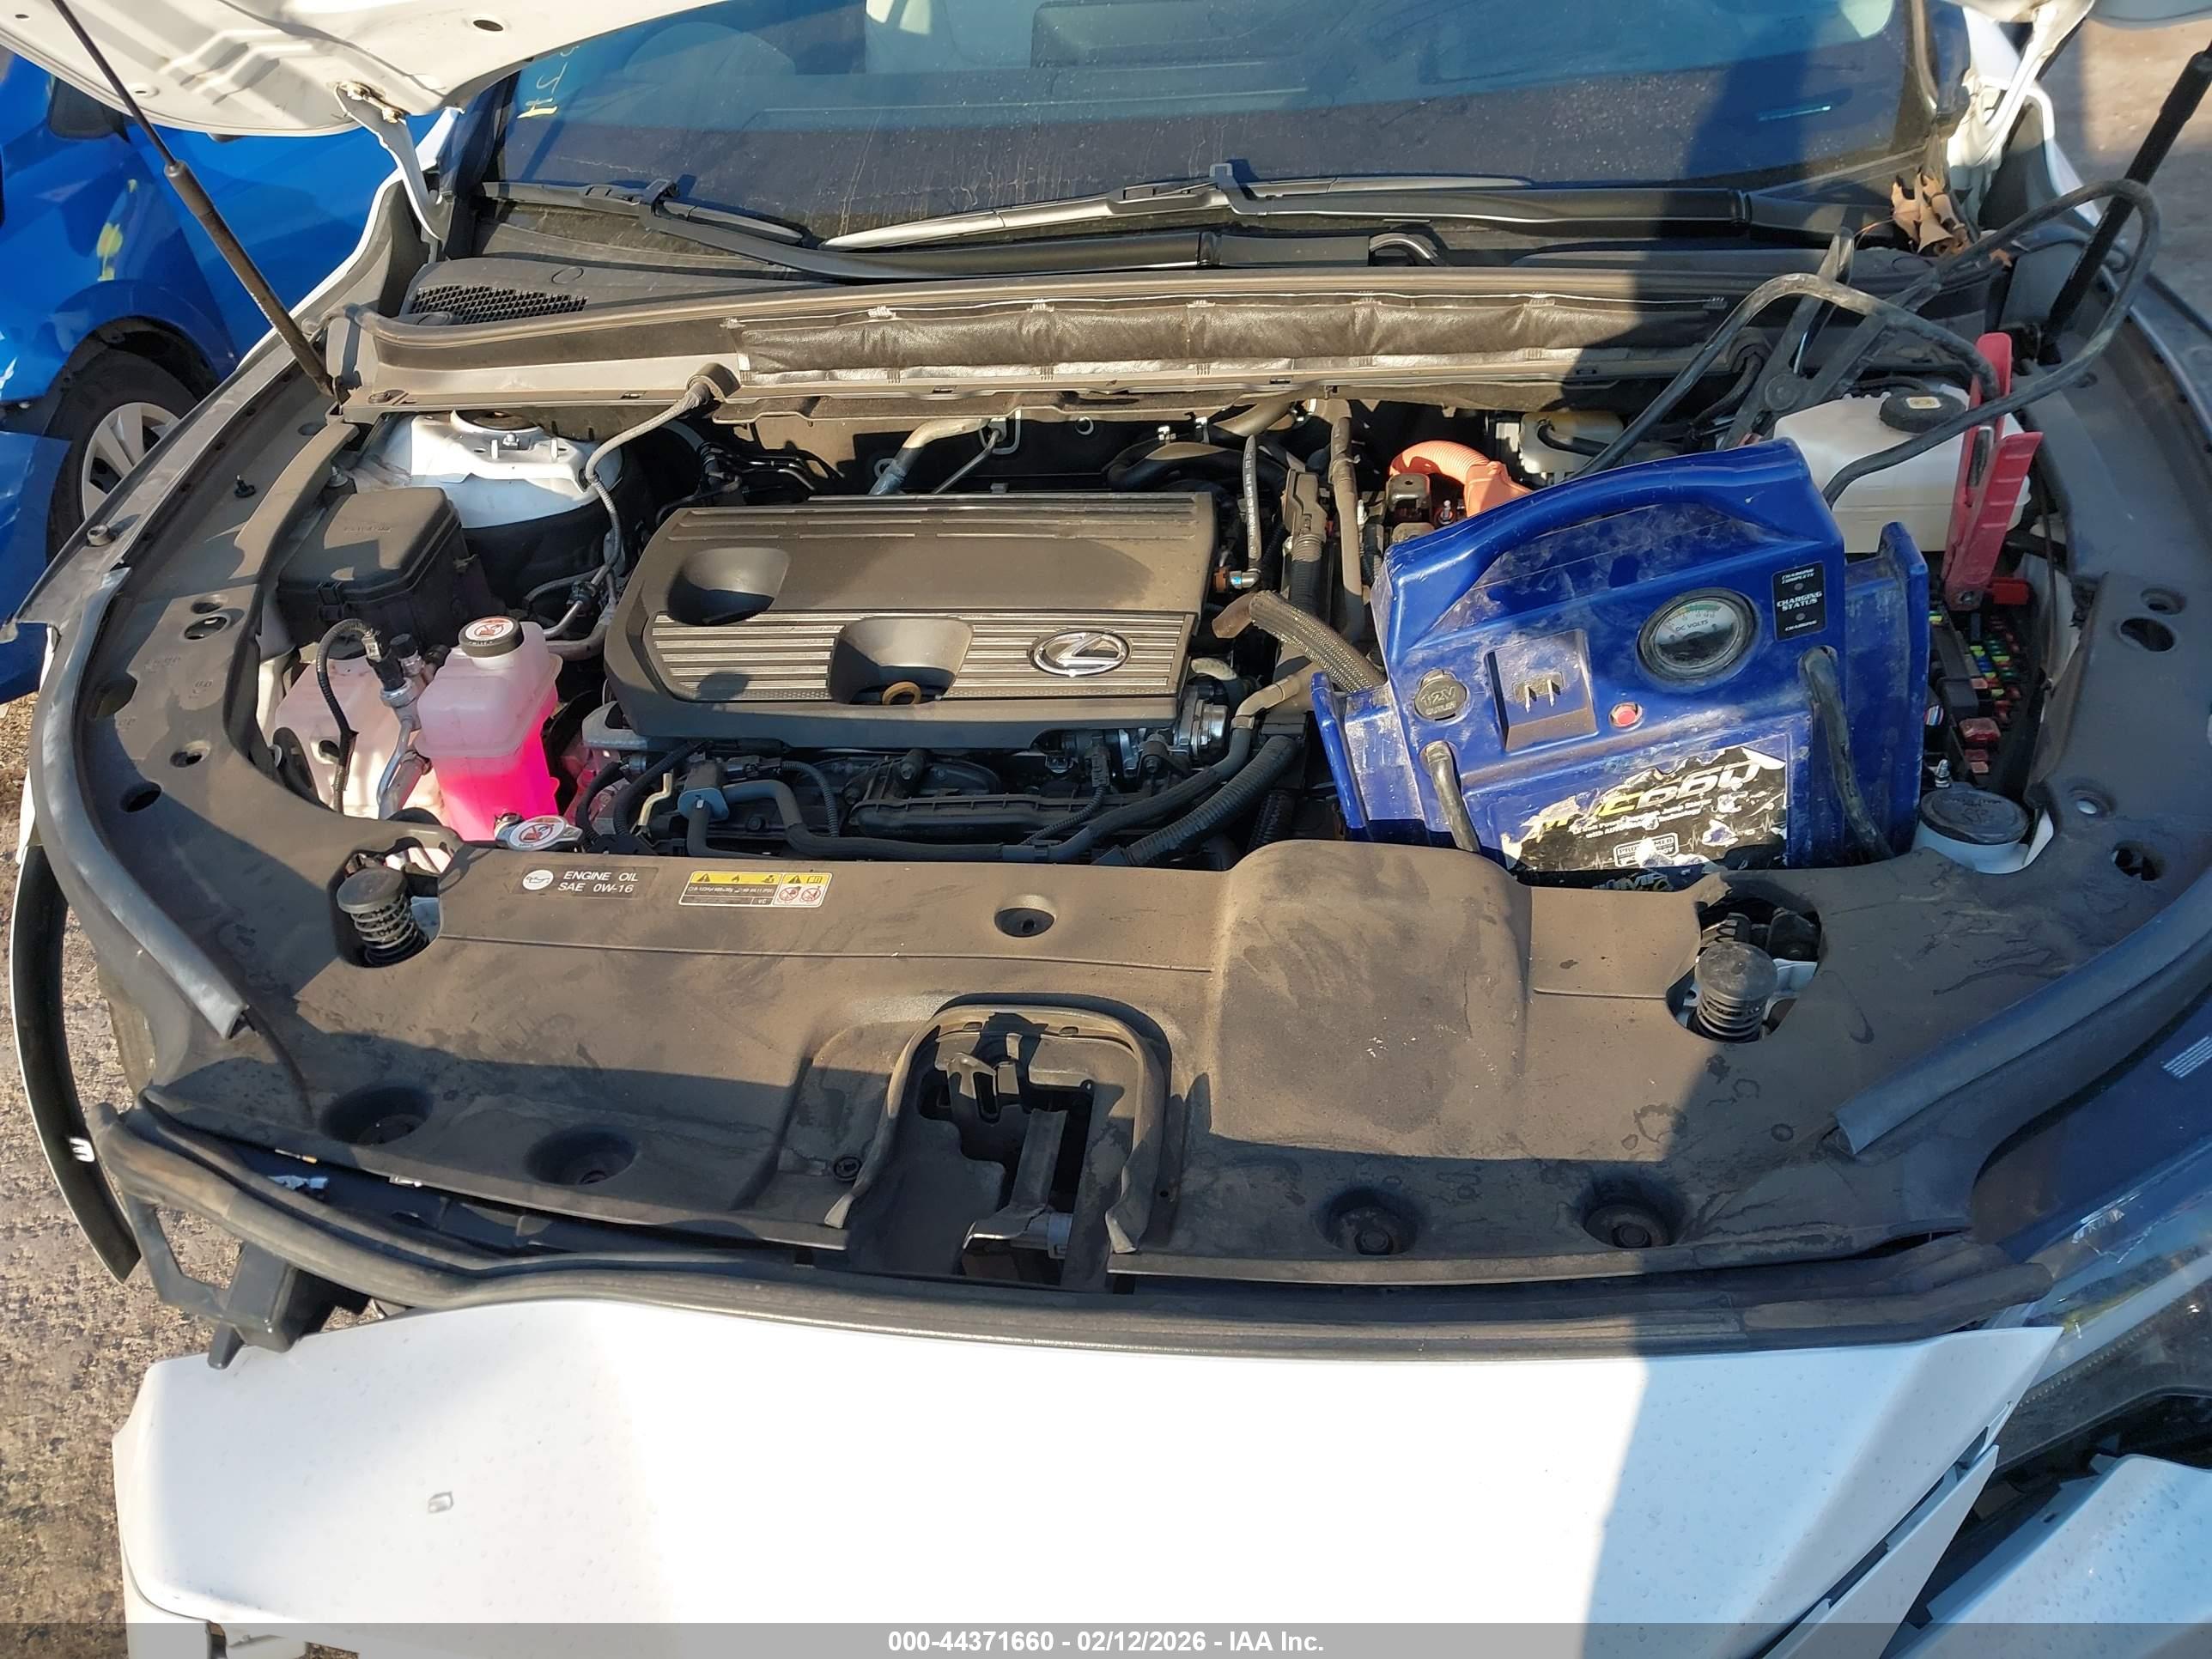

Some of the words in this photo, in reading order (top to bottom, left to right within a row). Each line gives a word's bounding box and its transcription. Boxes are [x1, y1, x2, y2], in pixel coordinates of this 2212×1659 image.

[1777, 591, 1822, 607] CHARGING
[1782, 598, 1818, 611] STATUS
[1687, 619, 1709, 629] VOLTS
[1420, 686, 1456, 705] 12V
[563, 871, 611, 881] ENGINE
[618, 872, 639, 882] OIL
[558, 882, 586, 892] SAE
[592, 884, 634, 893] 0W-16
